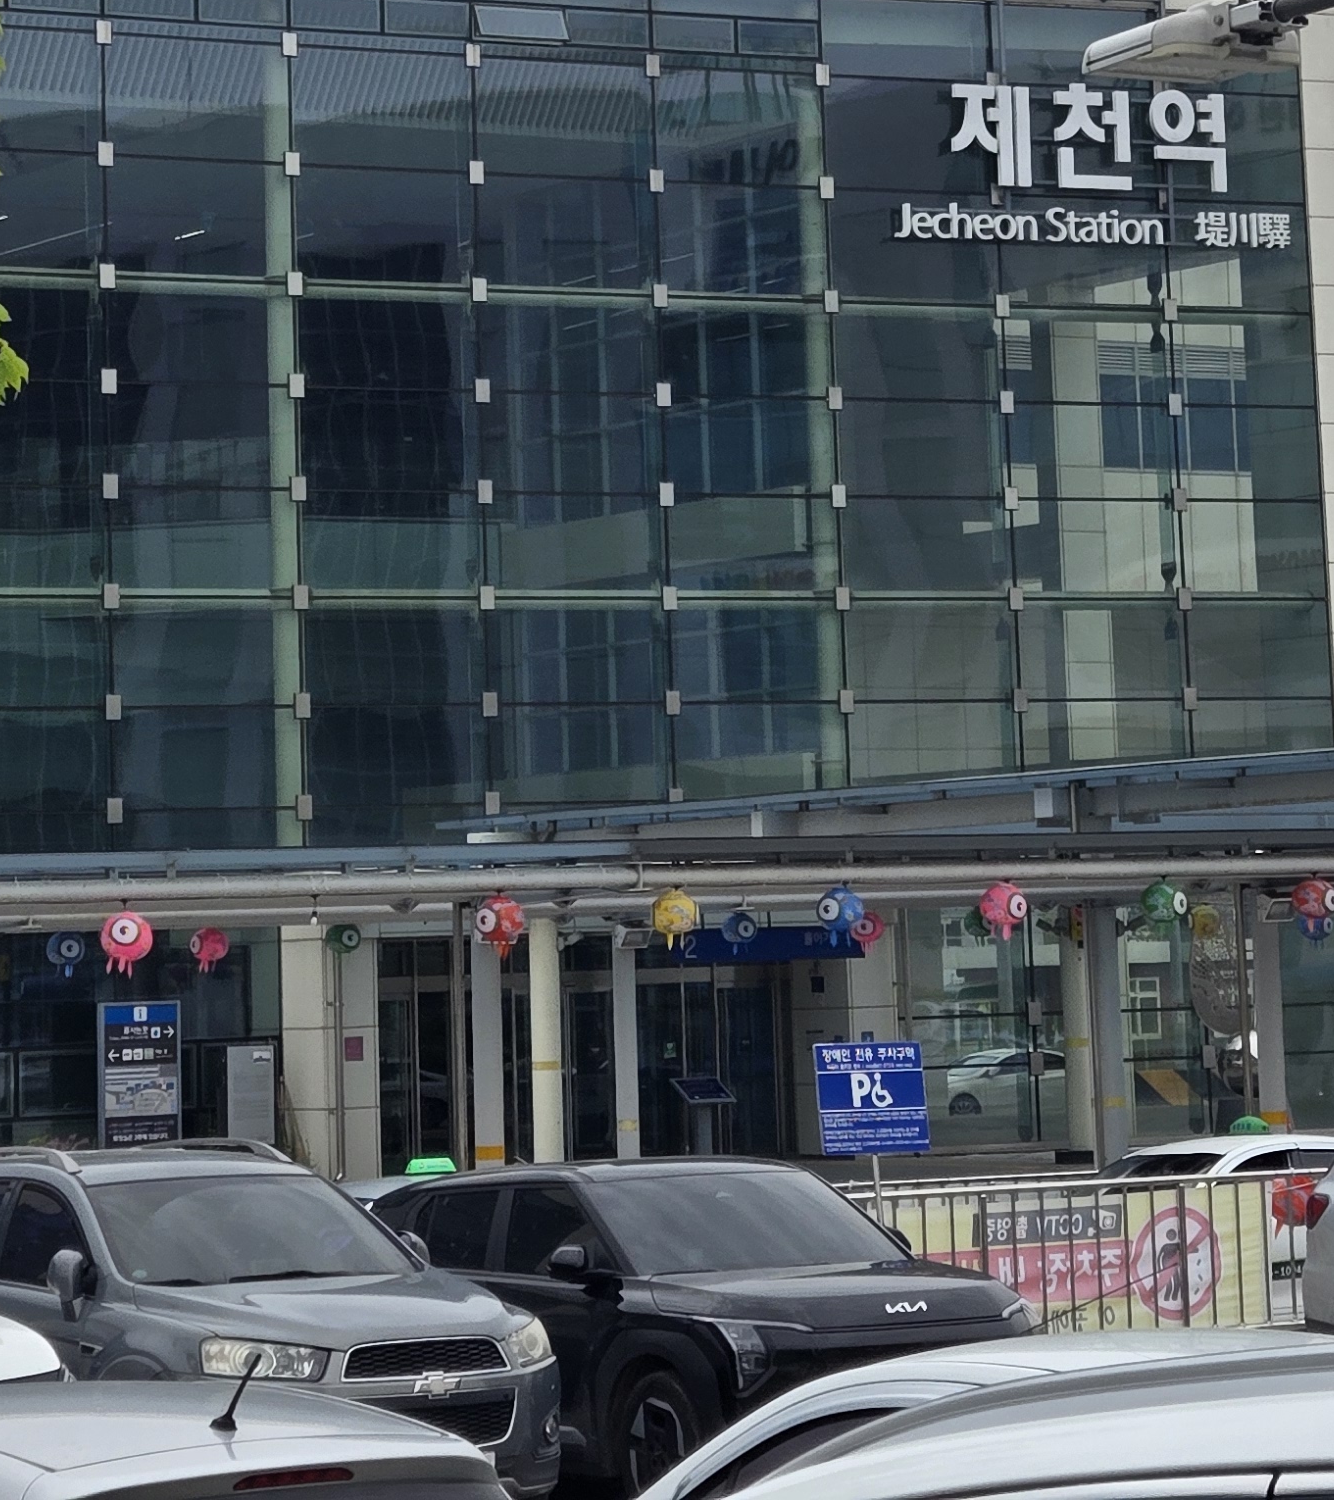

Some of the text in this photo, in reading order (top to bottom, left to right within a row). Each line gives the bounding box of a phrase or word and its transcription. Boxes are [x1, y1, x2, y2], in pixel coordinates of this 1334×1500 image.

[950, 82, 1228, 193] 제천역
[894, 202, 1165, 245] Jecheon Station
[1193, 211, 1292, 249] 堤川驛
[684, 934, 698, 959] 2
[850, 1073, 871, 1108] P
